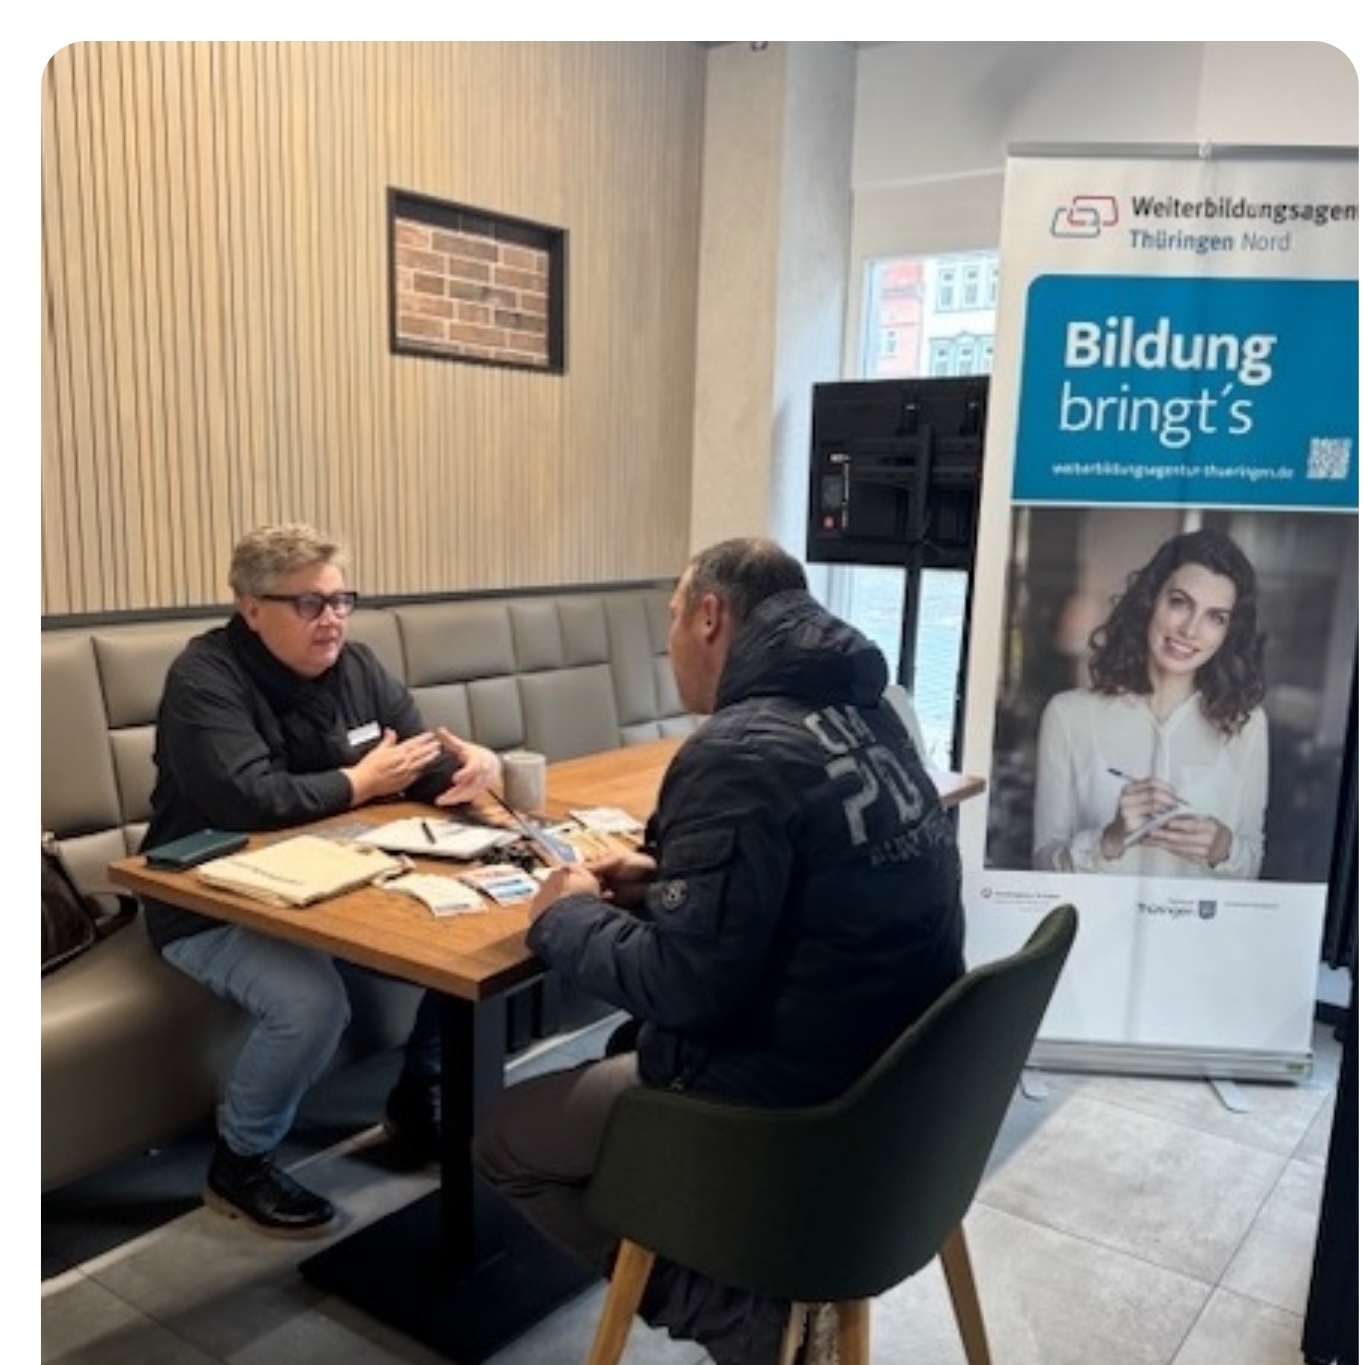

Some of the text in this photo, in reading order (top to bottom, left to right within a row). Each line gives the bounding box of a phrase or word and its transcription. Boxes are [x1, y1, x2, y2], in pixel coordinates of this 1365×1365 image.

[1131, 196, 1359, 226] Weiterbildungsagen
[1130, 229, 1291, 254] Thüringen Nord
[1064, 316, 1278, 386] Bildung
